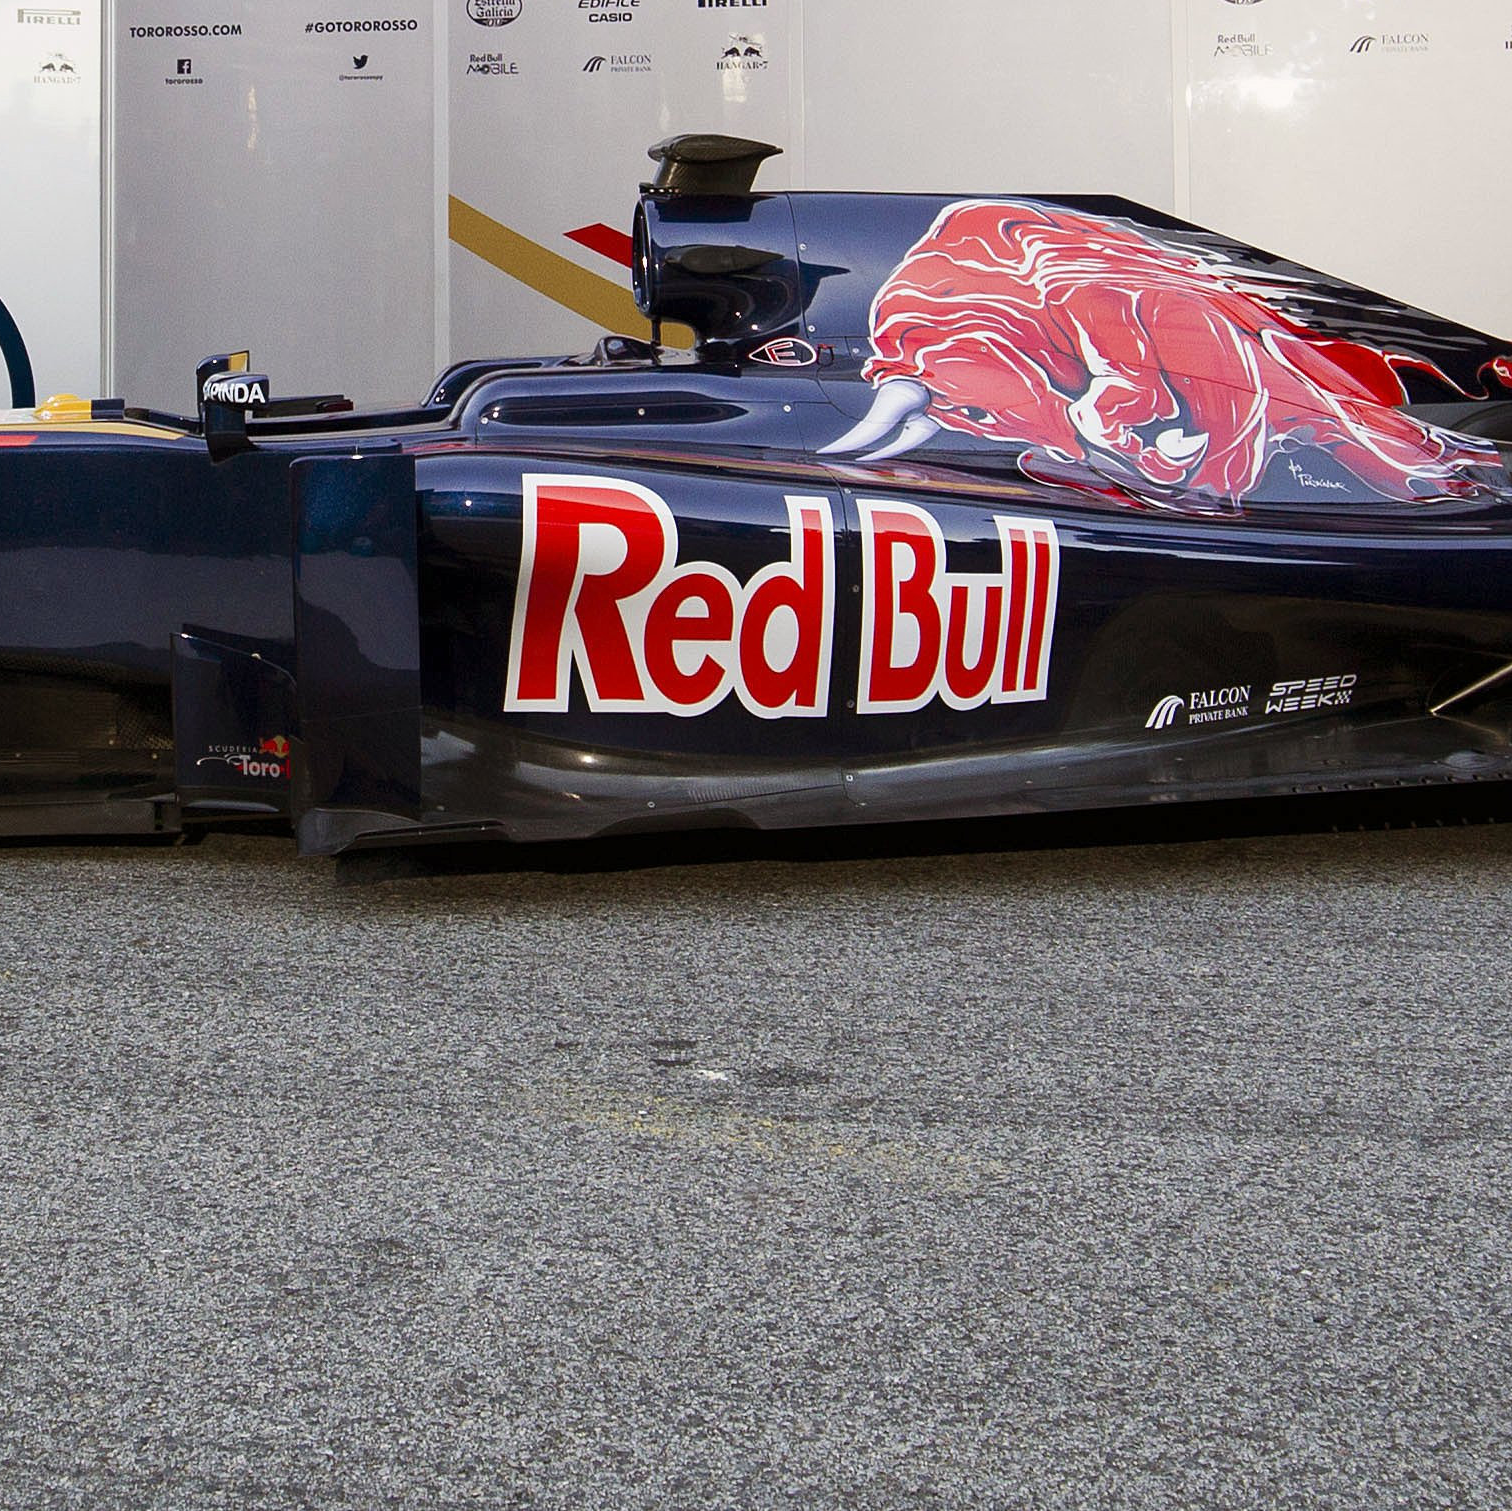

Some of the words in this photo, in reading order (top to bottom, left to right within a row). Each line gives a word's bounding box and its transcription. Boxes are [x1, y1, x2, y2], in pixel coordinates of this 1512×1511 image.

[17, 8, 81, 26] PIRELLI
[476, 6, 513, 18] Galicia
[588, 12, 633, 23] CASIO
[130, 25, 242, 38] TOROROSSO.COM
[305, 20, 418, 34] #GOTOROROSSO
[1380, 33, 1430, 45] FALCON
[611, 54, 652, 65] FALCON
[203, 381, 265, 404] SAPINDA
[502, 473, 833, 719] Red
[857, 498, 1060, 715] Bull
[1269, 674, 1357, 697] SPEED
[1189, 685, 1251, 710] FALCON
[1265, 692, 1337, 715] WEEK
[1189, 709, 1223, 725] PRIVATE
[1225, 706, 1249, 721] BANK
[208, 744, 258, 753] SCUDERIA
[241, 754, 281, 778] Toro
